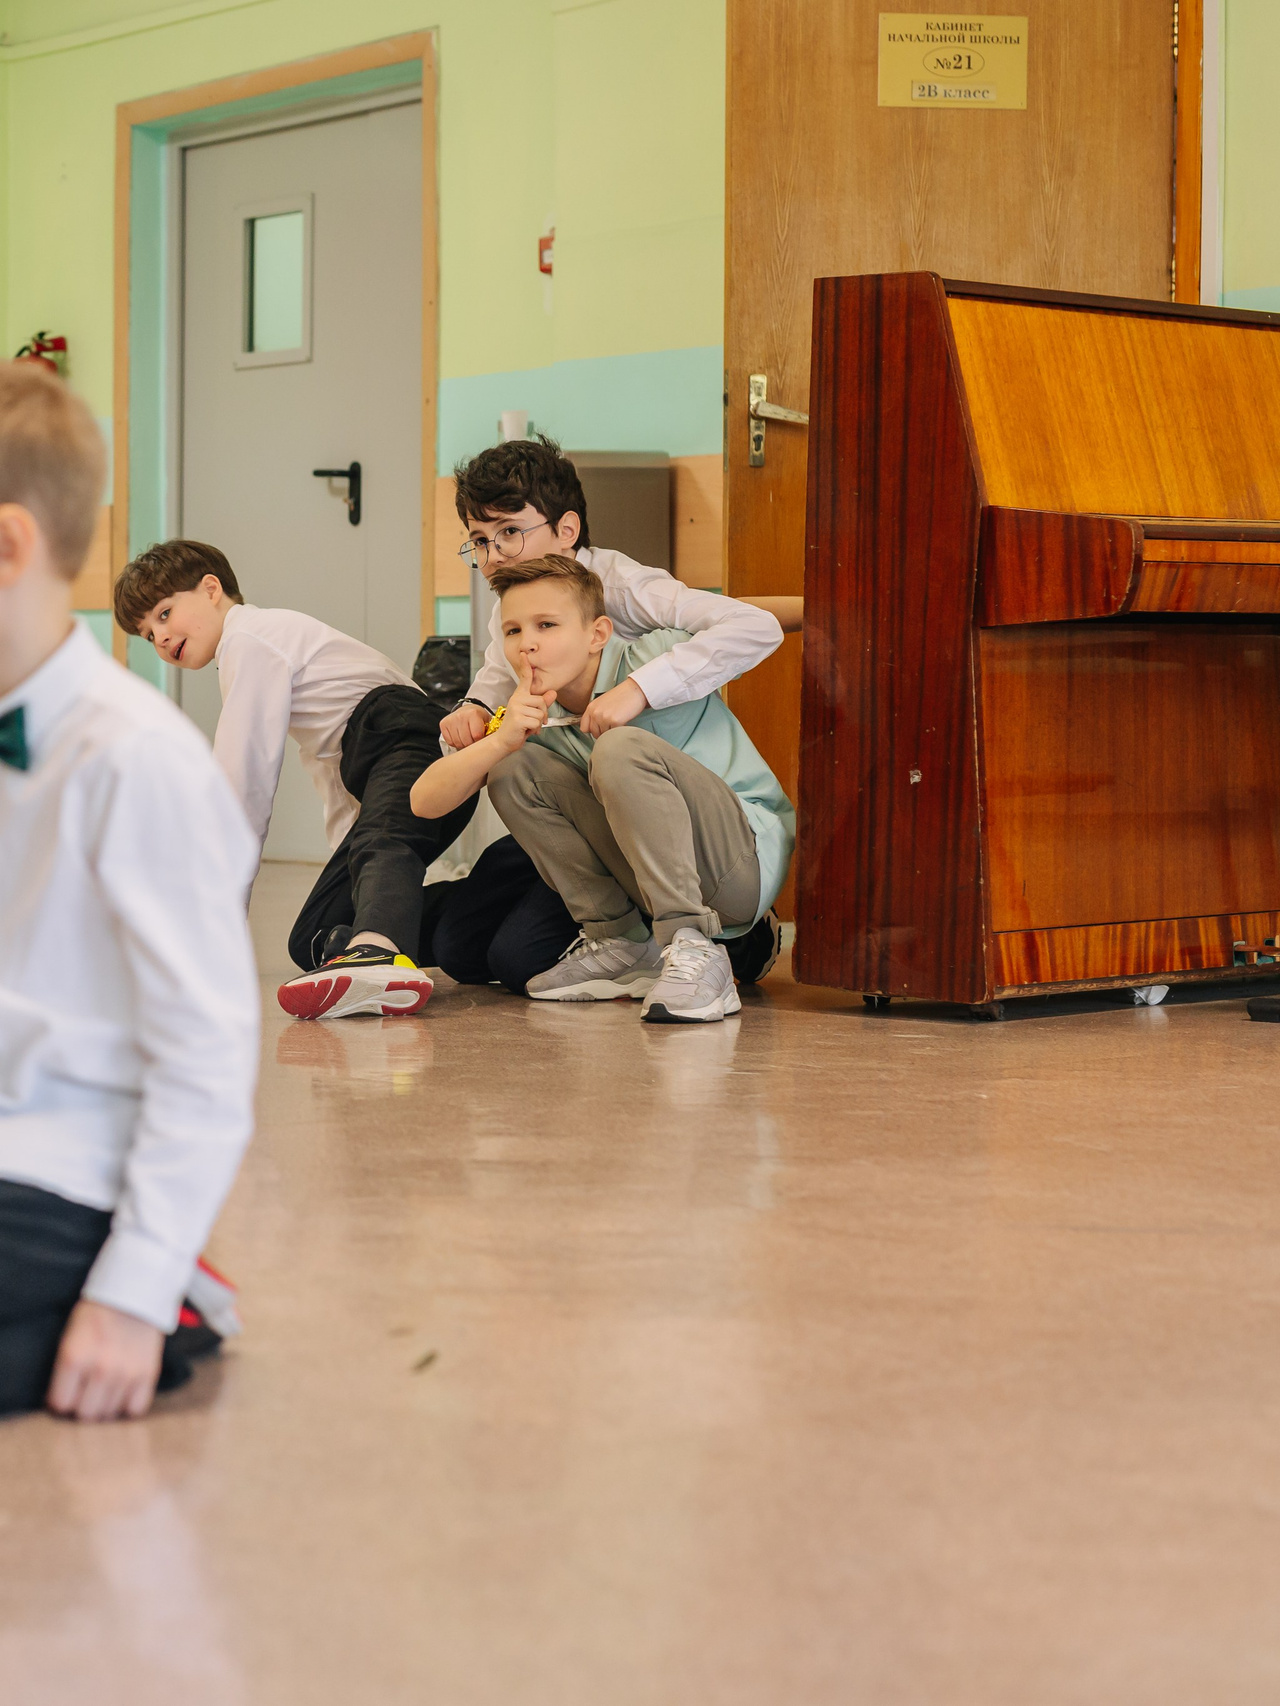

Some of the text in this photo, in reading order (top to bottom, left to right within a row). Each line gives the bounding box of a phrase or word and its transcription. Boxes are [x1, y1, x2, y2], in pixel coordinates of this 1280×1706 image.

[925, 22, 984, 32] КАБИНЕТ
[888, 32, 1020, 45] НАЧАЛЬНОЙ ШКОЛЫ
[918, 84, 990, 98] 2В класс
